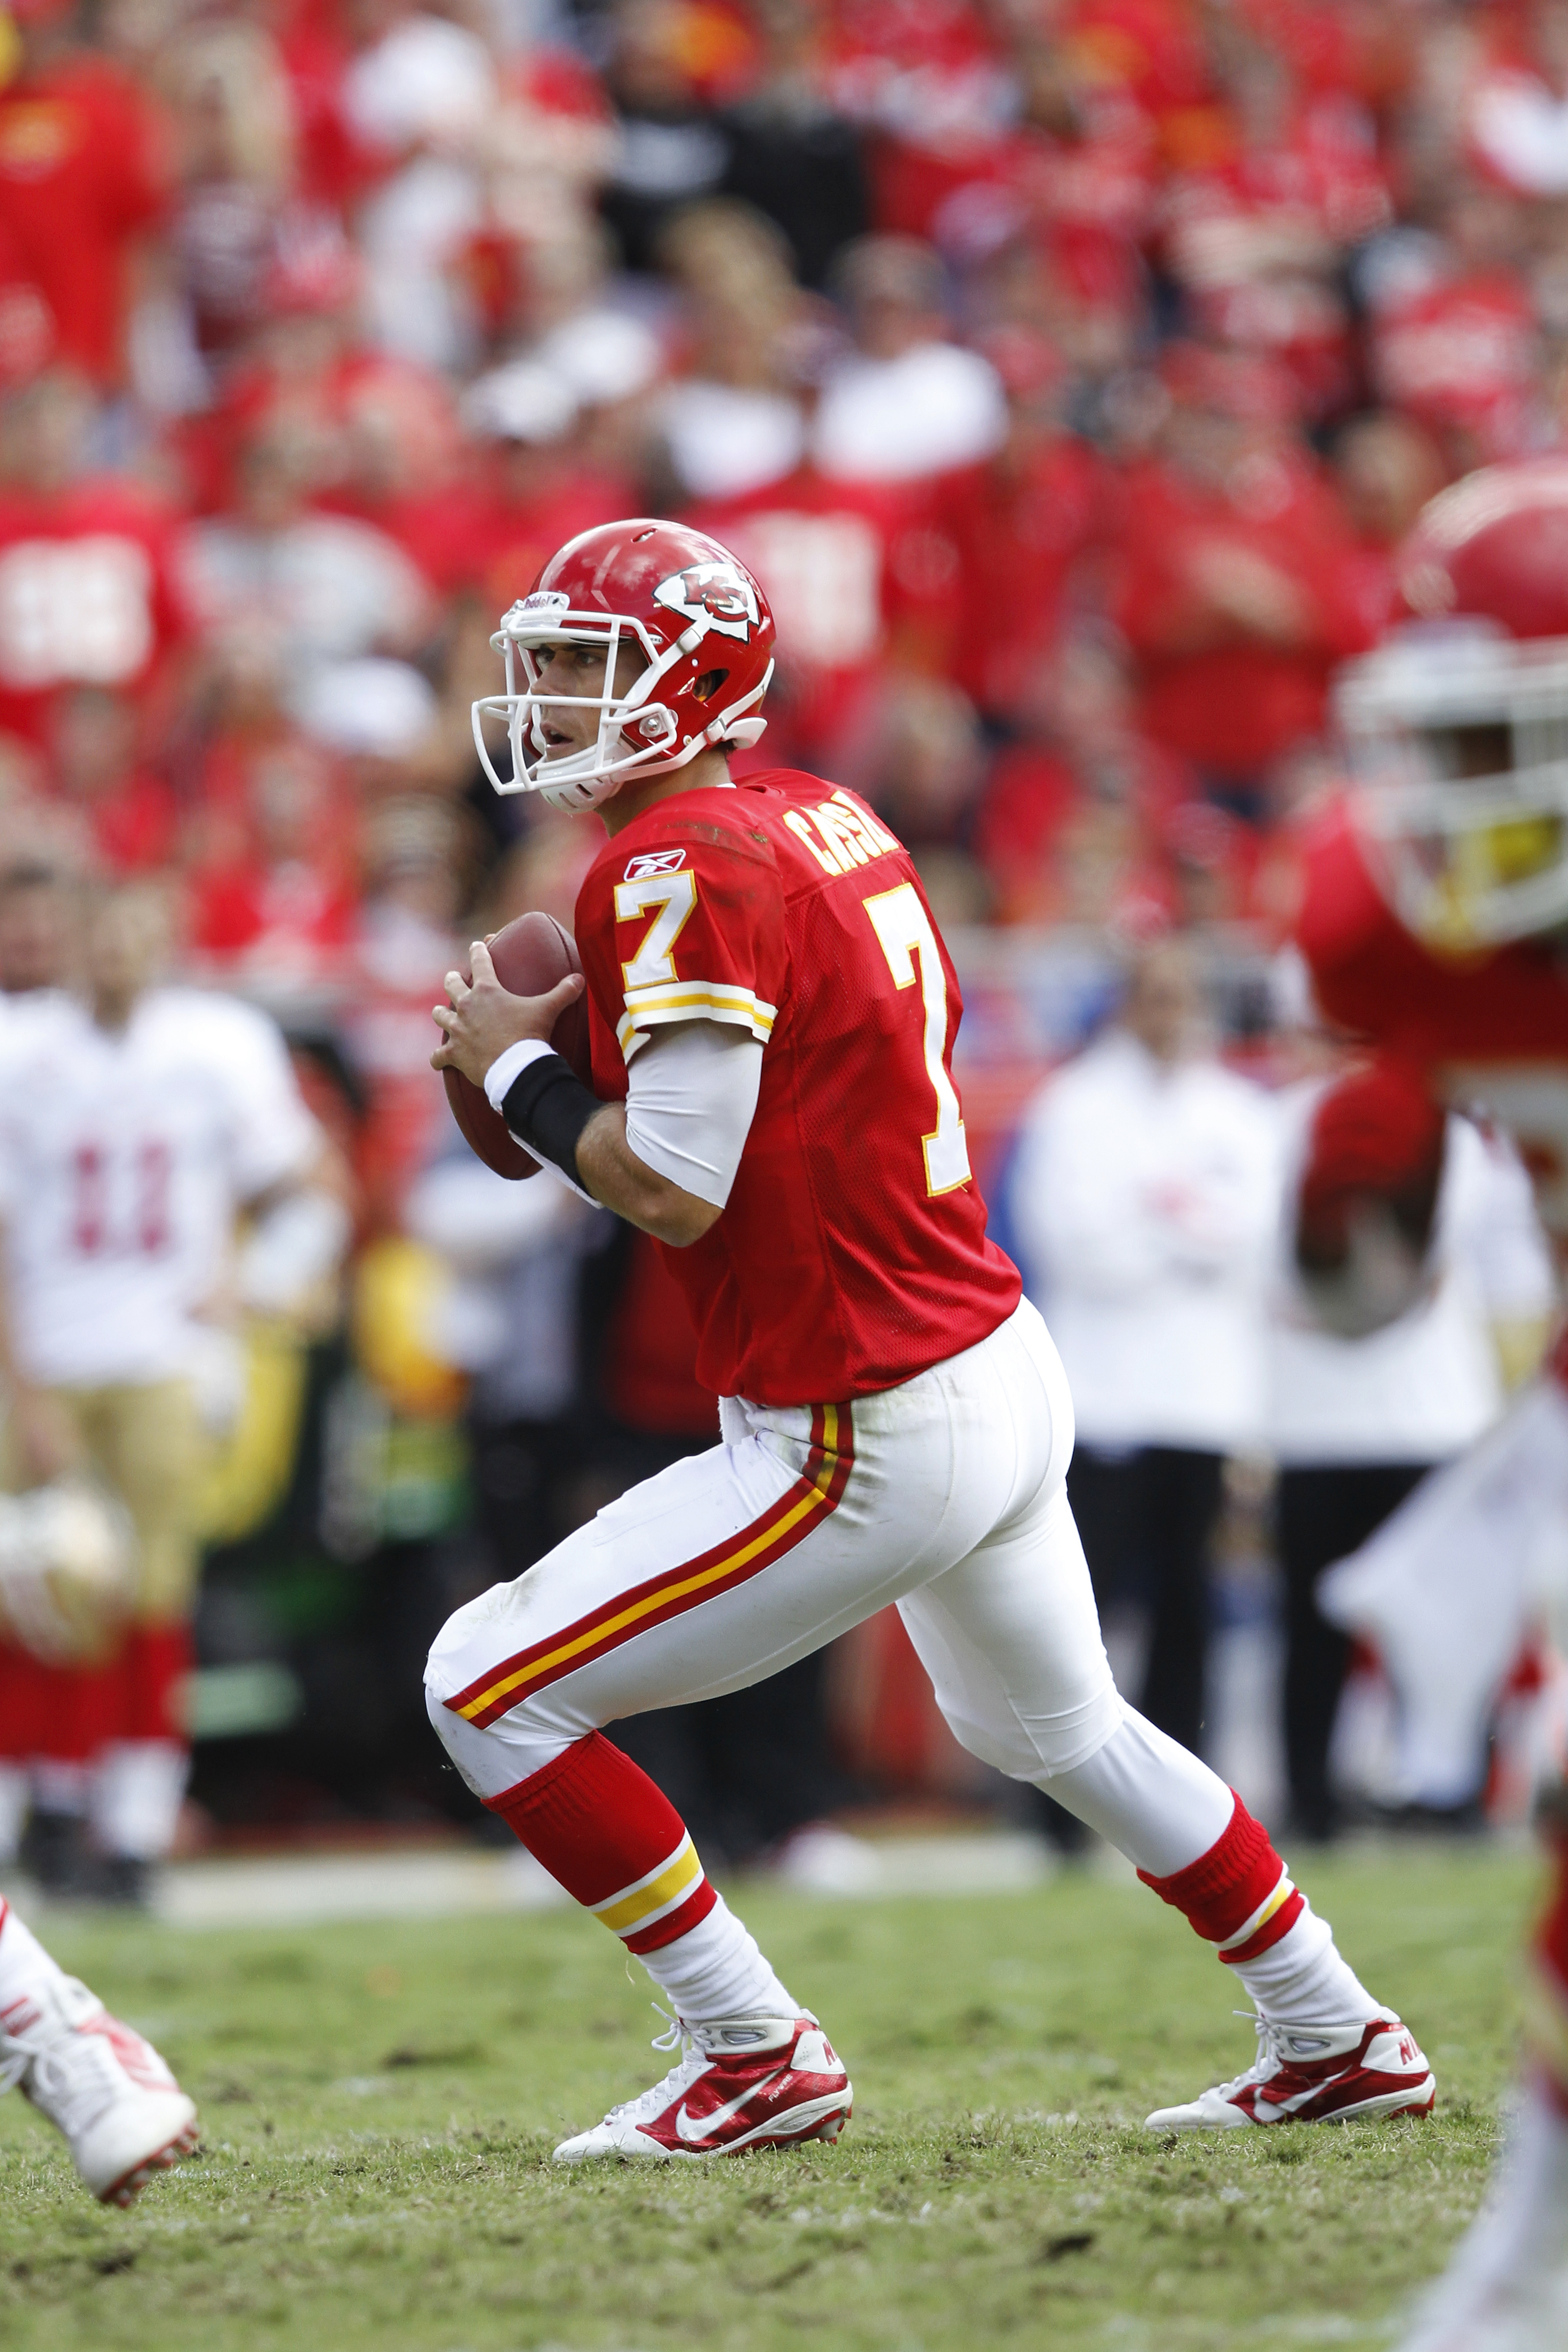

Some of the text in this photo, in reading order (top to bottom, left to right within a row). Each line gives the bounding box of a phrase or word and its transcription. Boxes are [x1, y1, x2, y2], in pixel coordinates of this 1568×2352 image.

[614, 869, 698, 991] 7
[862, 882, 972, 1197] 7
[768, 2073, 793, 2102] FLYWIRE
